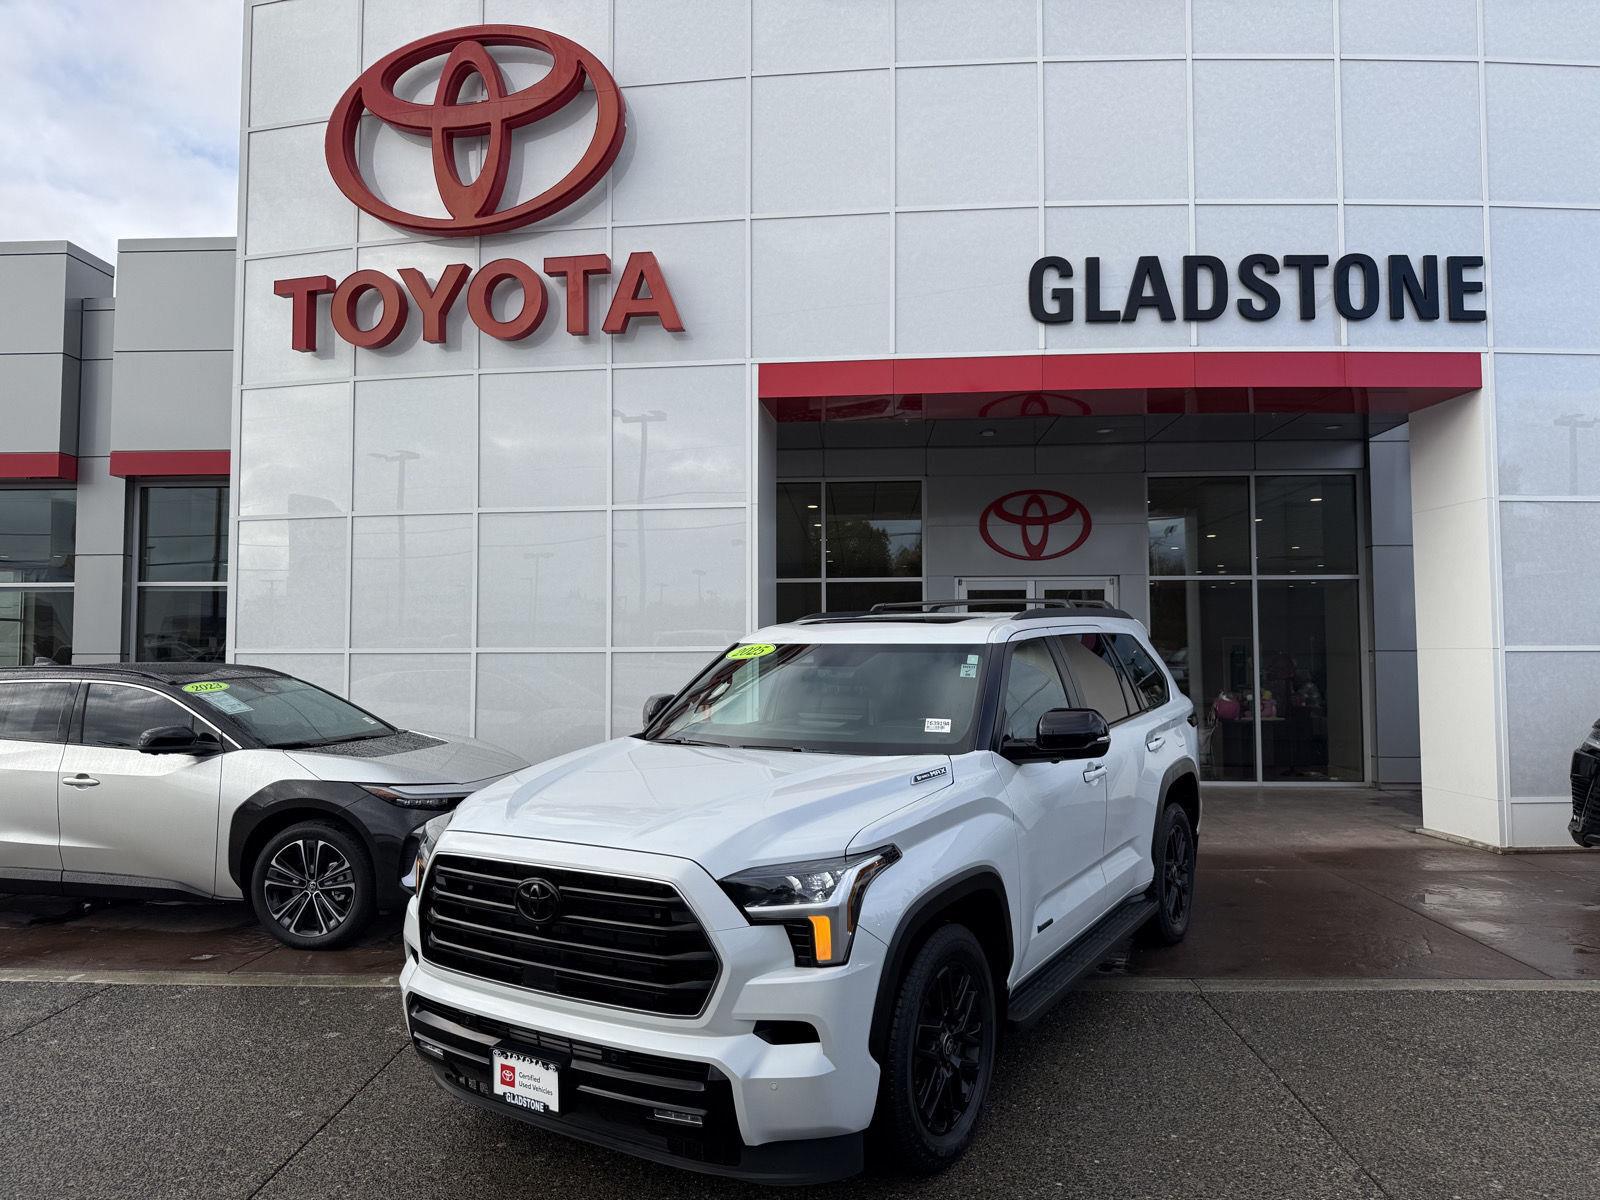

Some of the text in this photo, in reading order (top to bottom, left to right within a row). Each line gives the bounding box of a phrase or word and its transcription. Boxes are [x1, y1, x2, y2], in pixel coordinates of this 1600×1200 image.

[1028, 253, 1487, 323] GLADSTONE
[274, 251, 685, 353] TOYOTA
[930, 767, 946, 777] MAX
[519, 1071, 540, 1083] Certified
[519, 1080, 553, 1095] Used Vehicles
[505, 1092, 545, 1112] GLADSTONE
